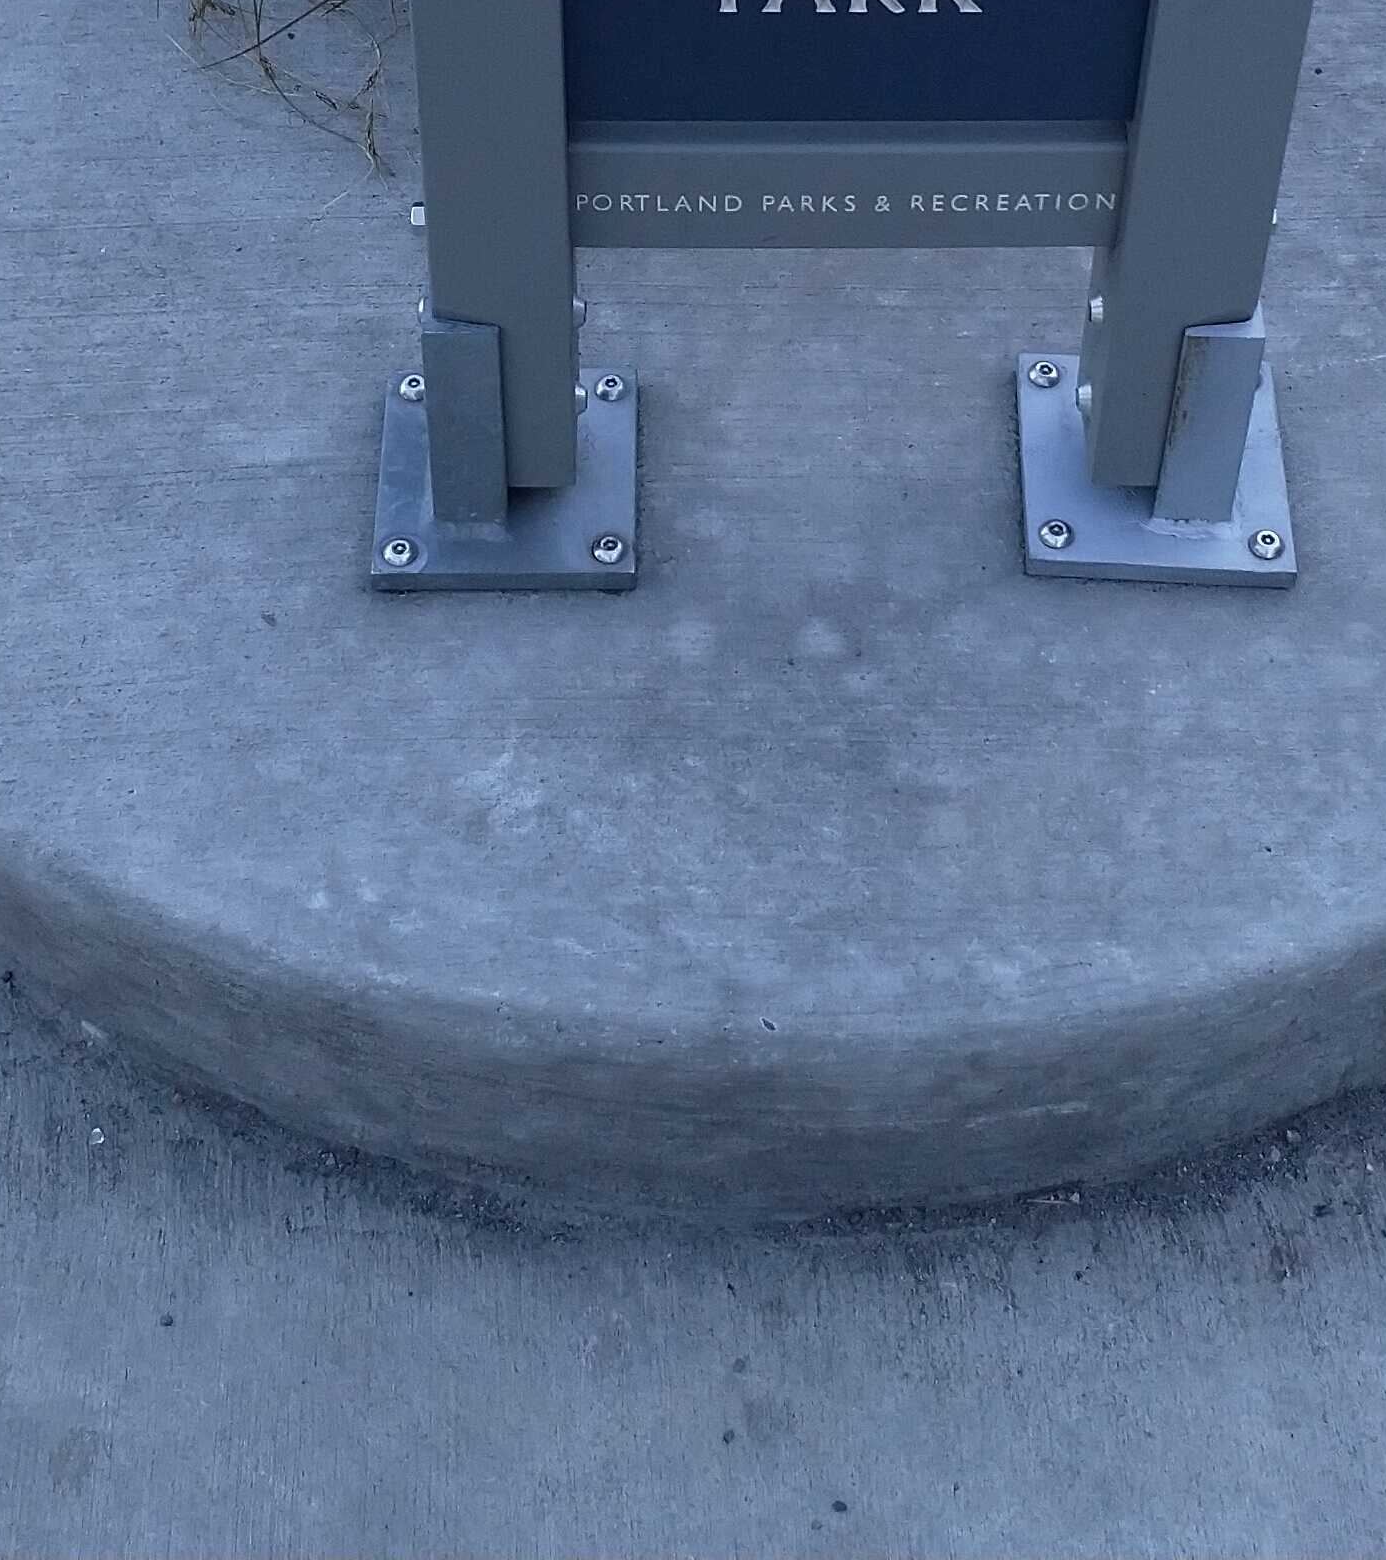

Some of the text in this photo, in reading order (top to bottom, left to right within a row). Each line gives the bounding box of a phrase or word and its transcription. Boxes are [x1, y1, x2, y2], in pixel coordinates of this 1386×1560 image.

[575, 191, 1117, 213] PORTLAND PARKS & RECREATION
